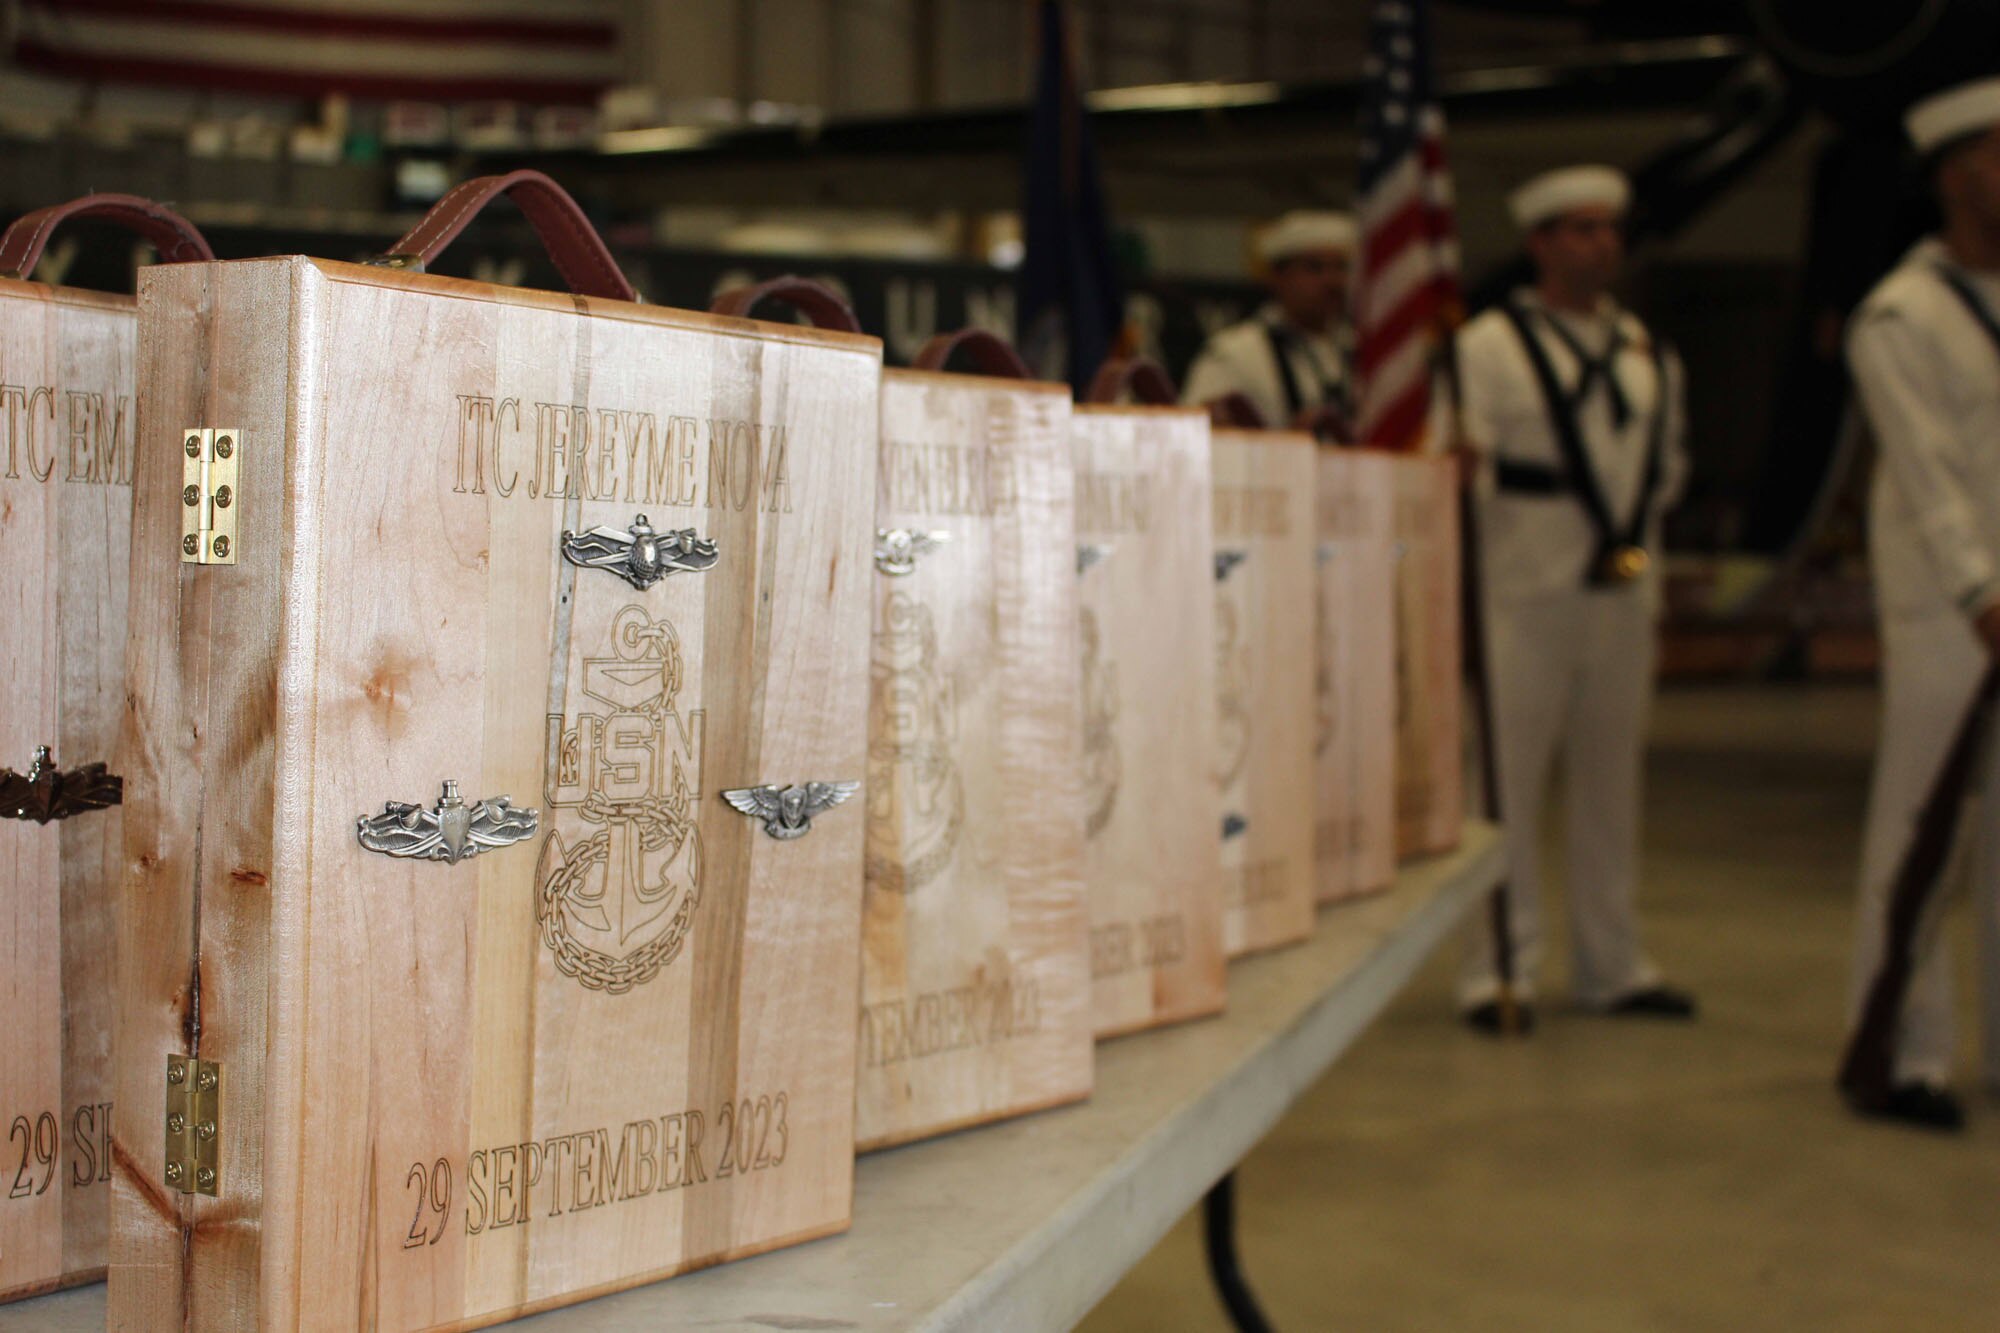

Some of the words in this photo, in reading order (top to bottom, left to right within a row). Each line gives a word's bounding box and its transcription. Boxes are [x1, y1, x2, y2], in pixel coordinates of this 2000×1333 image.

[453, 394, 520, 498] ITC
[528, 402, 697, 507] JEREYME
[704, 418, 793, 514] NOVA
[9, 1110, 58, 1199] 29
[403, 1157, 452, 1250] 29
[465, 1109, 709, 1236] SEPTEMBER
[715, 1091, 789, 1180] 2023
